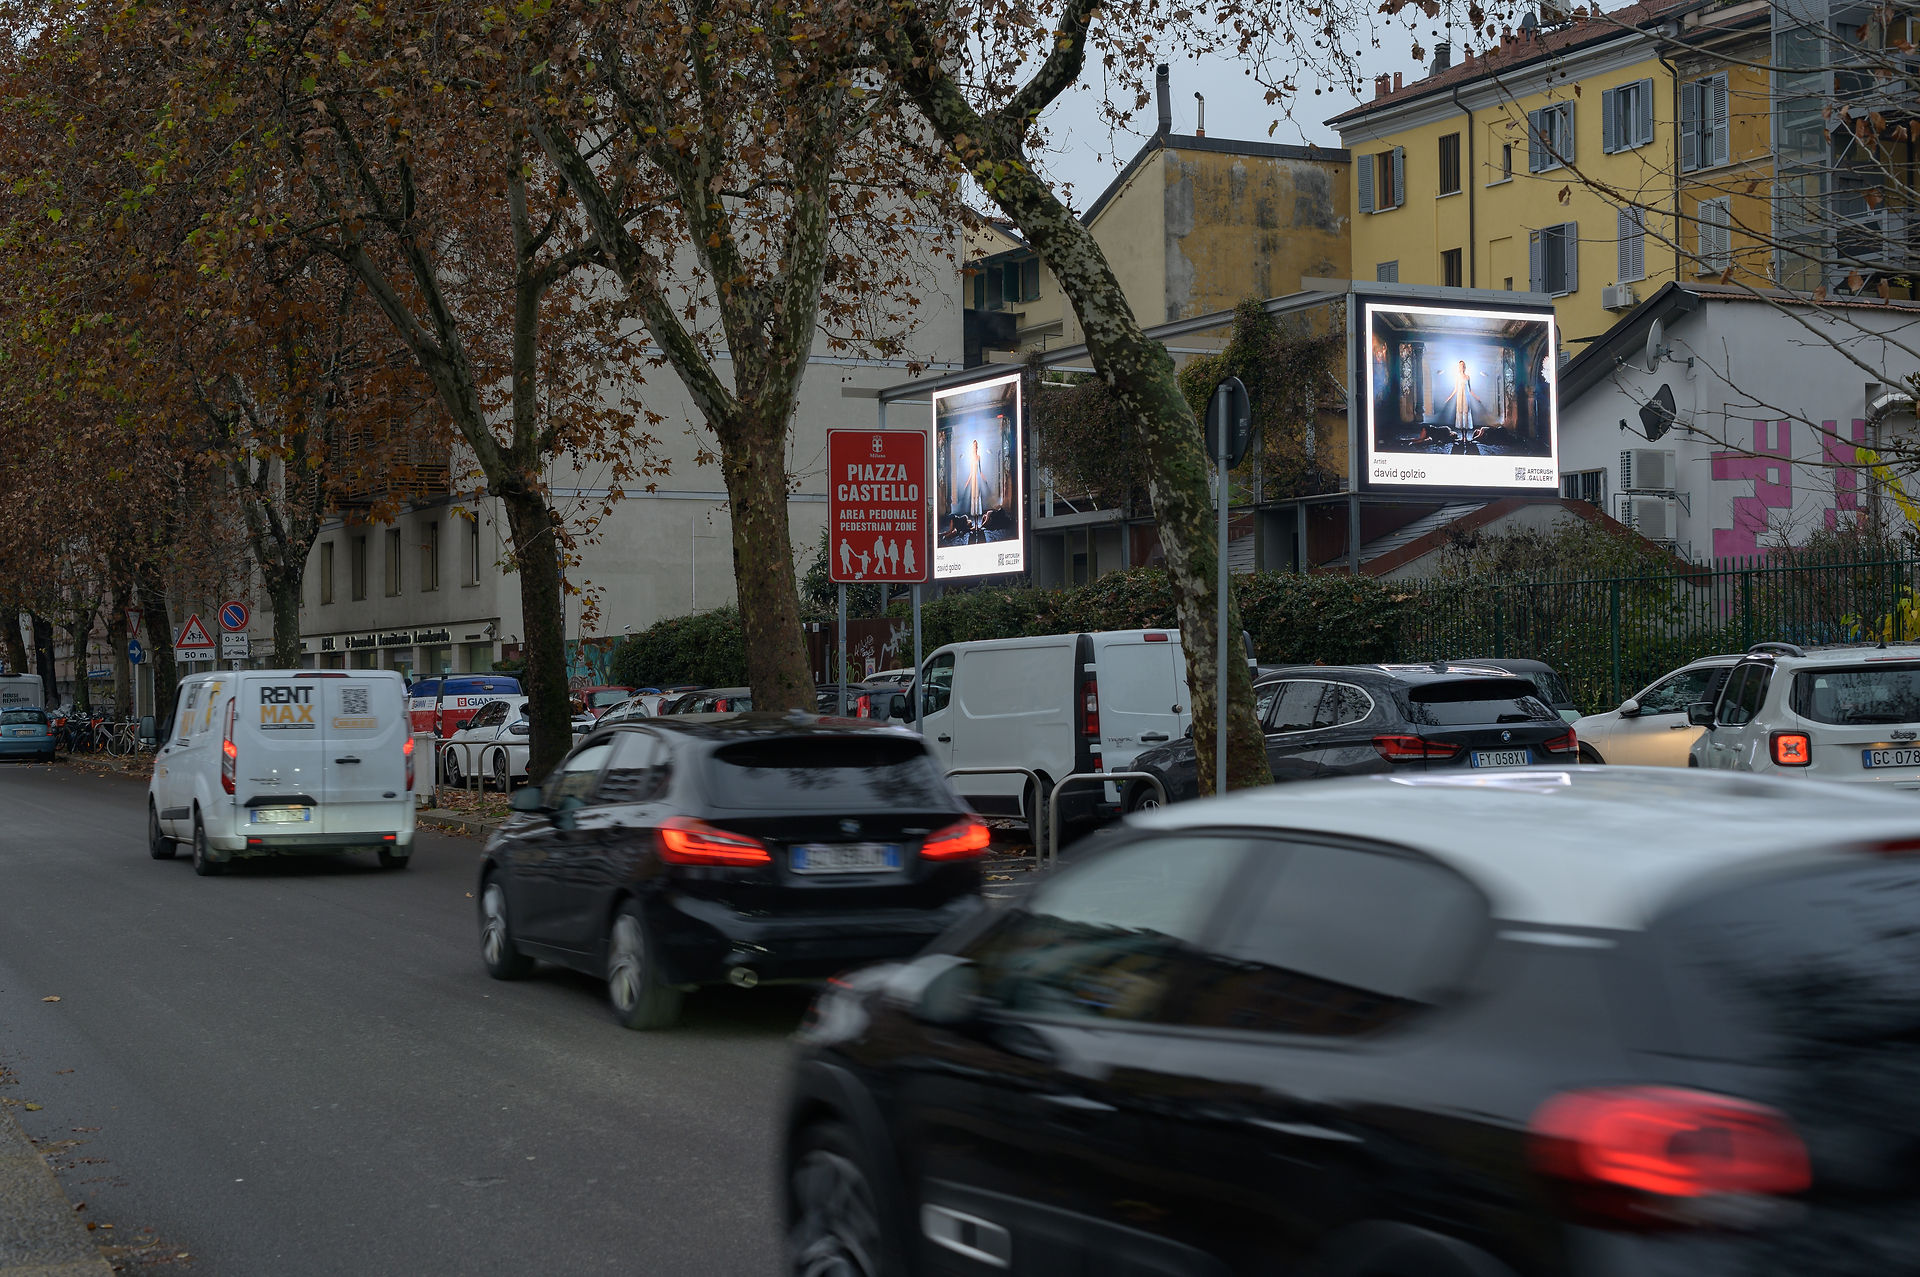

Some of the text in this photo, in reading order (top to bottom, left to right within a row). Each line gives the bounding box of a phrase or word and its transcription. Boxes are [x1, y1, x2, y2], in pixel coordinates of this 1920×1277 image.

[847, 463, 908, 481] PIAZZA
[1373, 468, 1426, 481] david golzio
[837, 484, 919, 502] CASTELLO
[840, 509, 918, 520] AREA PEDONALE
[840, 522, 917, 532] PEDESTRIAN ZONE
[936, 564, 949, 572] david
[184, 651, 196, 659] 50
[260, 686, 315, 704] RENT
[260, 705, 315, 723] MAX
[1890, 729, 1918, 740] Jeep
